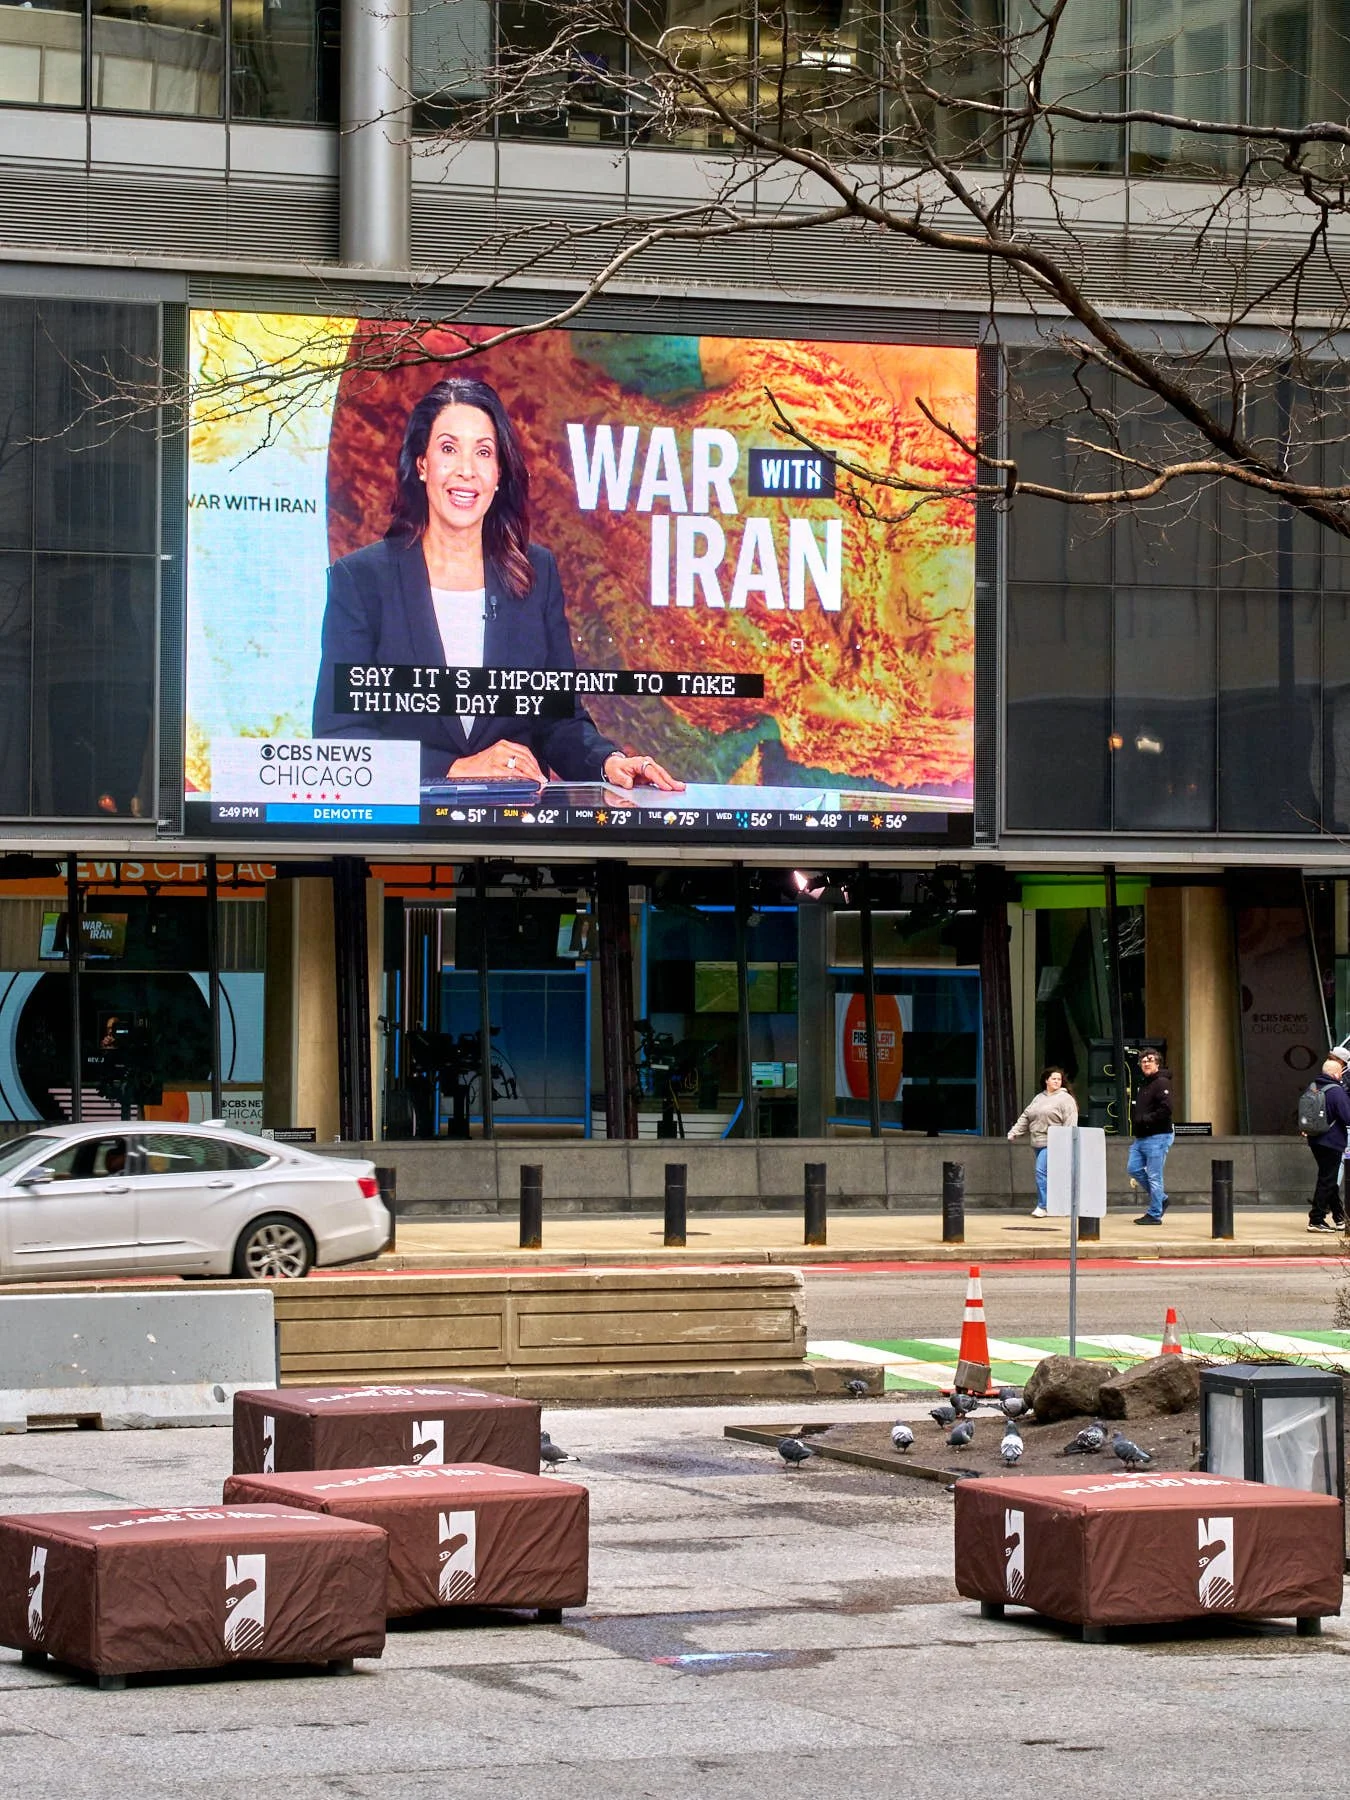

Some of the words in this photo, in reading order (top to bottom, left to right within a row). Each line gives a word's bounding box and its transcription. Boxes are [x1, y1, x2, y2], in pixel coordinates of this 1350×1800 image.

[566, 423, 739, 514] WAR
[761, 458, 821, 489] WITH
[224, 495, 270, 511] WITH
[275, 498, 316, 513] IRAN
[651, 514, 842, 612] IRAN
[350, 666, 395, 687] SAY
[413, 668, 471, 689] IT'S
[488, 670, 618, 692] IMPORTANT
[634, 674, 663, 693] TO
[678, 675, 736, 695] TAKE
[350, 692, 441, 713] THINGS
[455, 694, 499, 714] DAY
[515, 696, 544, 715] BY
[277, 744, 312, 761] CBS
[317, 745, 372, 762] NEWS
[259, 765, 372, 787] CHICAGO
[219, 806, 241, 818] 2:49
[242, 807, 259, 818] PM
[313, 808, 373, 820] DEMOTTE
[436, 808, 448, 816] SAT
[503, 809, 519, 817] SUN
[575, 810, 593, 818] MON
[648, 811, 662, 819] TUE
[715, 812, 732, 820] WED
[789, 813, 803, 821] THU
[857, 814, 869, 822] FRI
[82, 920, 103, 930] WAR
[90, 929, 113, 940] IRAN
[228, 1100, 247, 1108] CBS
[249, 1100, 263, 1108] NE
